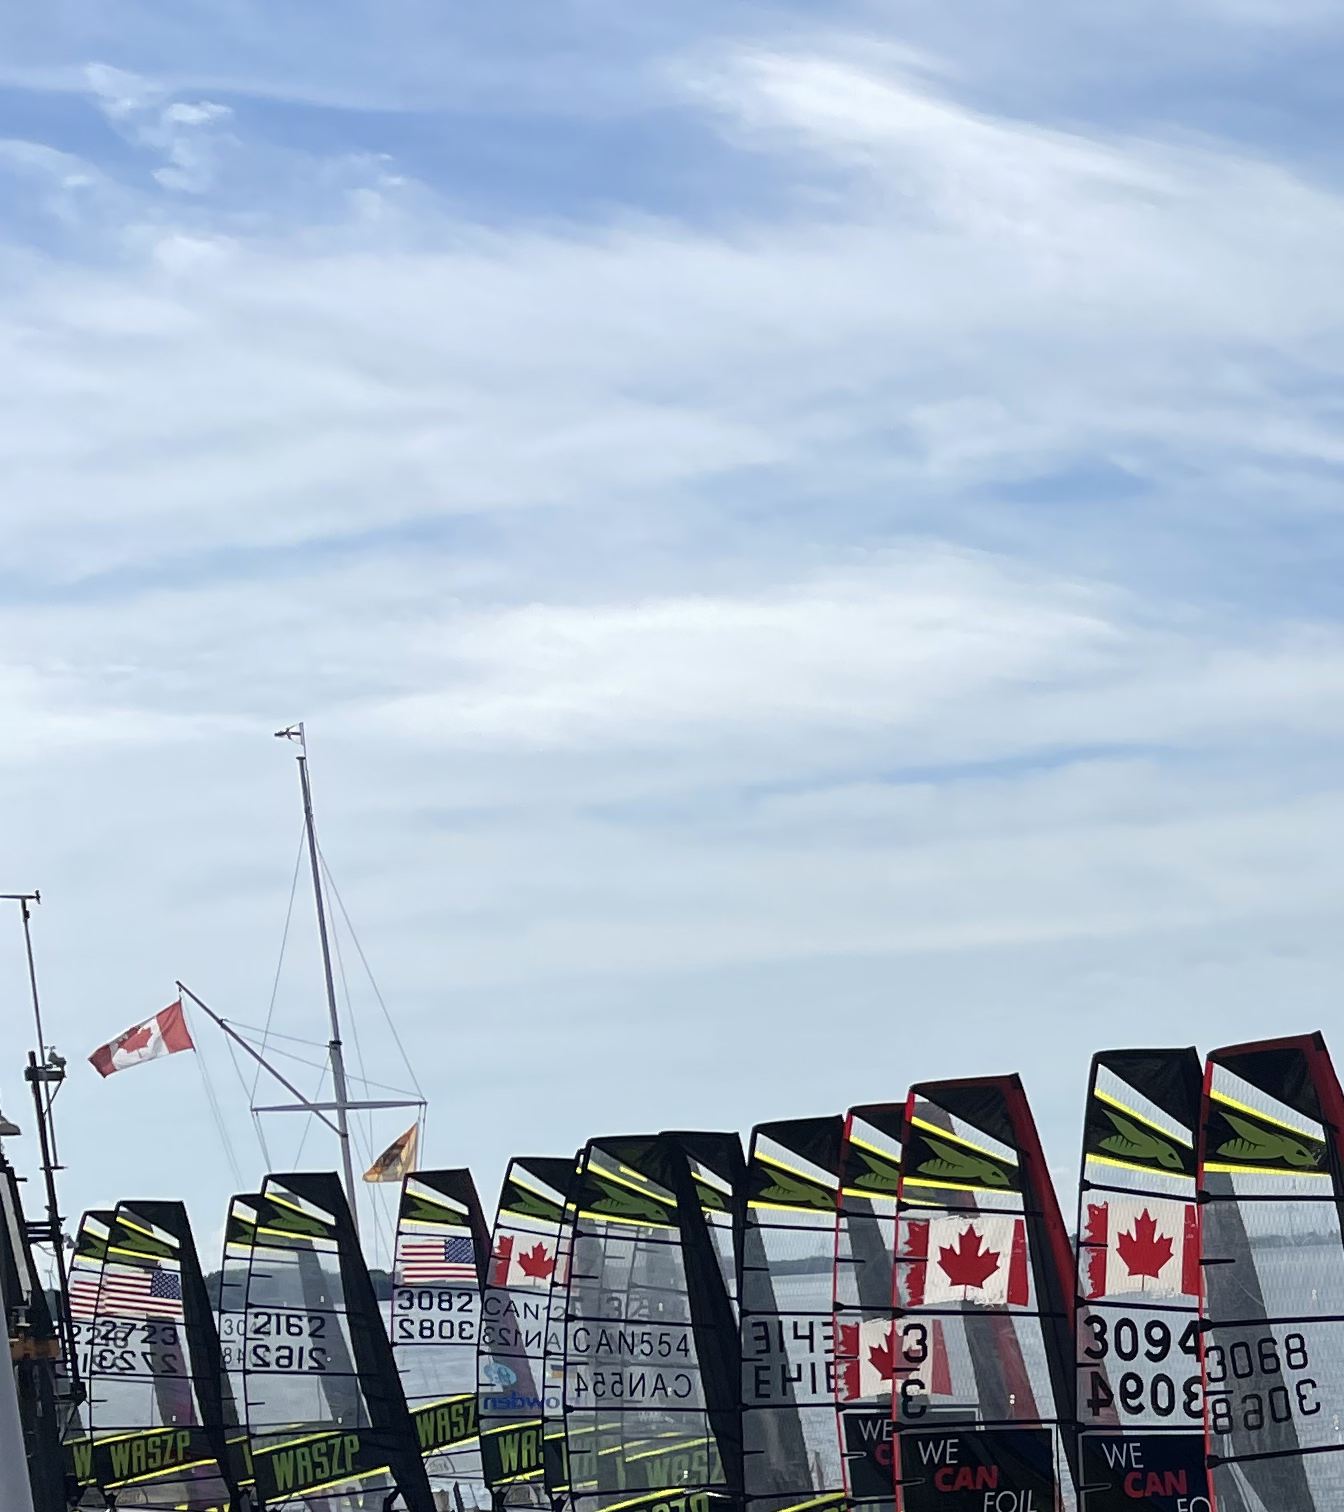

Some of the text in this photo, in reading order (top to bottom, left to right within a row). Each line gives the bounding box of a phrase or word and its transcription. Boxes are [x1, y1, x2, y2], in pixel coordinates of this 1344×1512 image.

[397, 1289, 474, 1313] 3082
[100, 1320, 178, 1346] 2723
[253, 1311, 326, 1339] 2162
[1083, 1314, 1203, 1363] 3094
[572, 1327, 690, 1358] CAN554
[1204, 1332, 1309, 1383] 3068
[415, 1400, 478, 1449] WASZ
[109, 1430, 191, 1479] WASZP
[271, 1434, 360, 1492] WASZP
[917, 1438, 960, 1466] WE
[1101, 1442, 1145, 1470] WE
[934, 1465, 999, 1493] CAN
[1123, 1469, 1188, 1499] CAN
